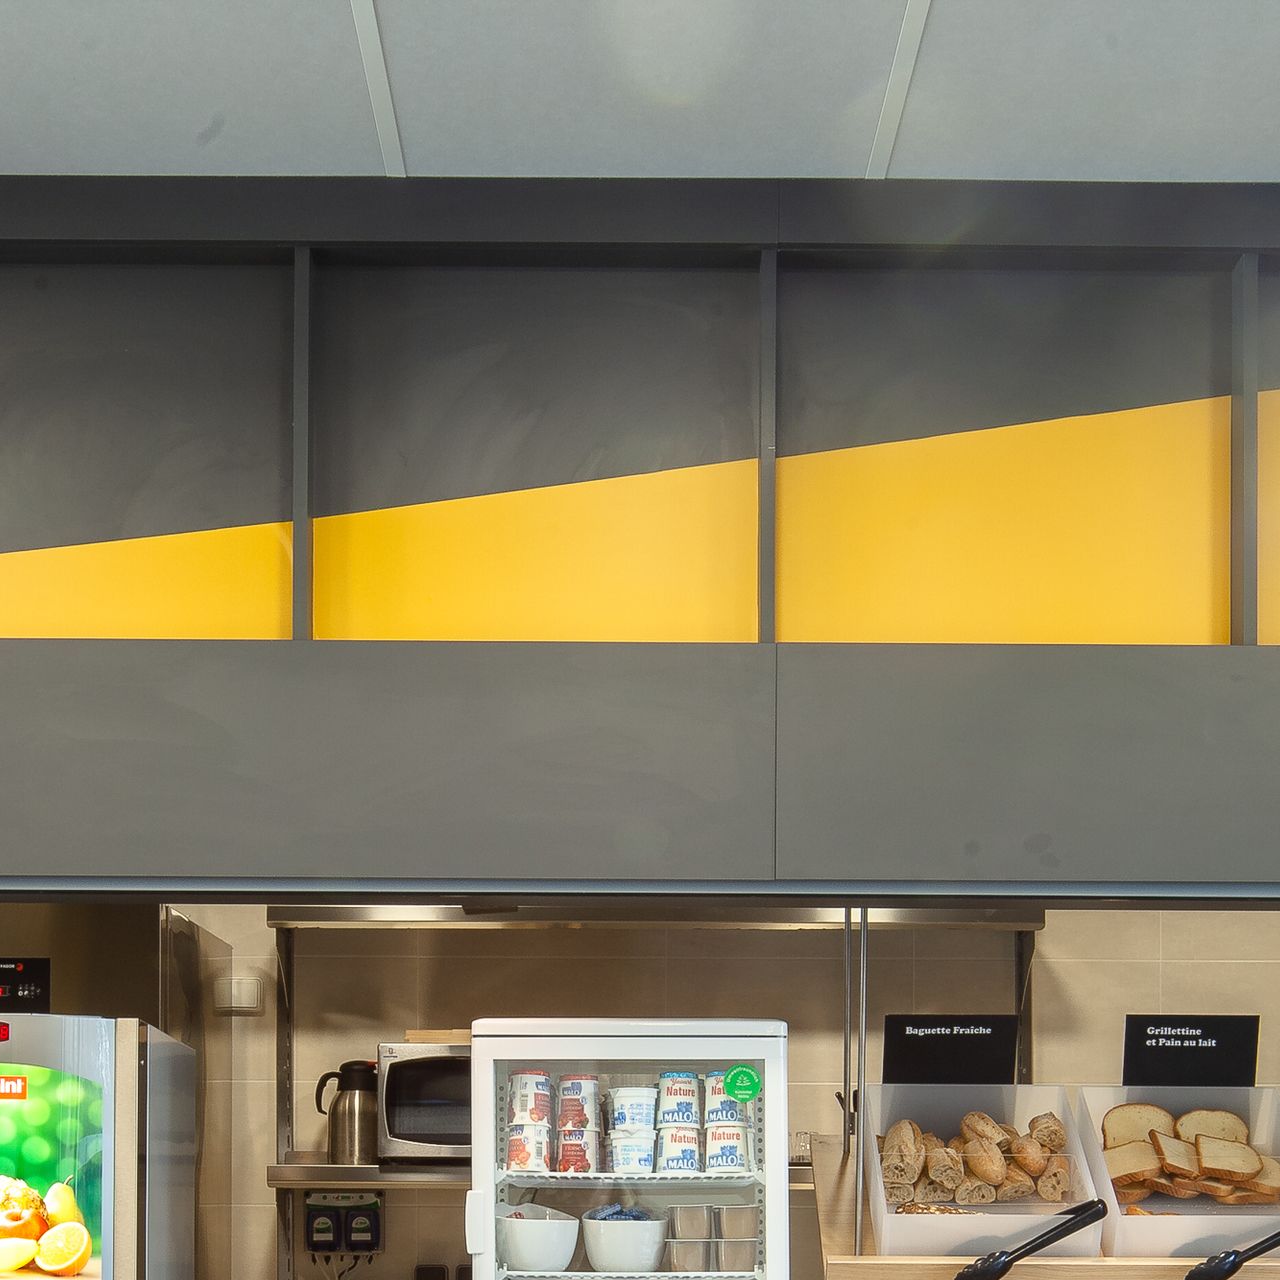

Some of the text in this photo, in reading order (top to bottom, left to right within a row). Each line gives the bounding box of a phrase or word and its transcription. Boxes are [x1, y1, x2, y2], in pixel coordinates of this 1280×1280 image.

[905, 1026, 992, 1036] Baguette Fraîche
[1146, 1026, 1202, 1035] Grillettine
[1145, 1038, 1157, 1046] et
[1158, 1038, 1181, 1046] Pain
[1198, 1038, 1217, 1047] lait
[666, 1086, 695, 1097] Nature
[663, 1111, 693, 1123] MALO
[709, 1110, 737, 1121] MALO
[711, 1131, 741, 1142] Nature
[668, 1159, 696, 1170] MALO
[710, 1155, 737, 1167] MALO
